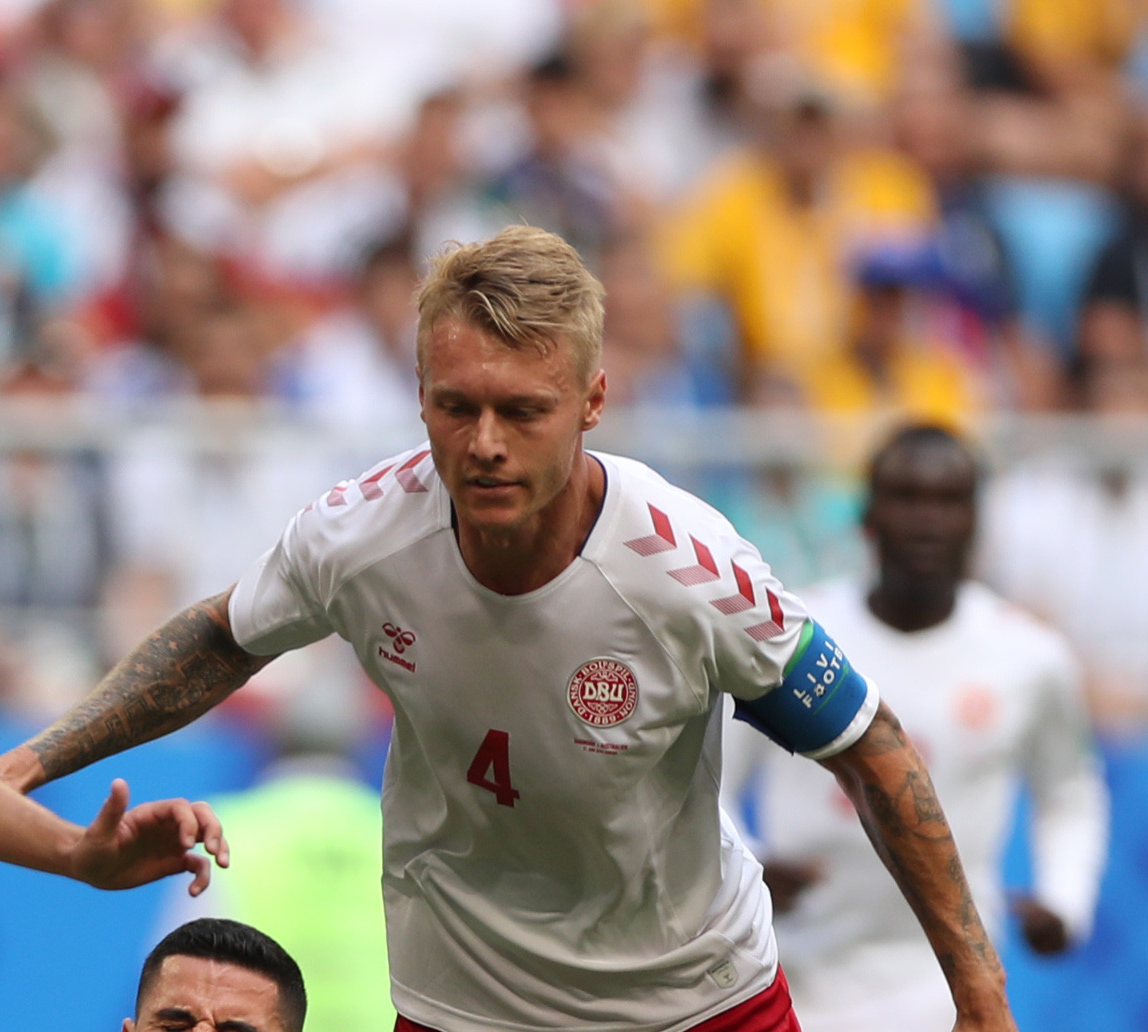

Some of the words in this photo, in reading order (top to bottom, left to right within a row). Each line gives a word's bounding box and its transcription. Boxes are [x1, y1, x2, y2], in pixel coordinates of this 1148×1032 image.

[378, 645, 416, 673] hummel
[582, 681, 625, 702] DBU
[587, 714, 618, 725] 1889
[466, 728, 521, 809] 4
